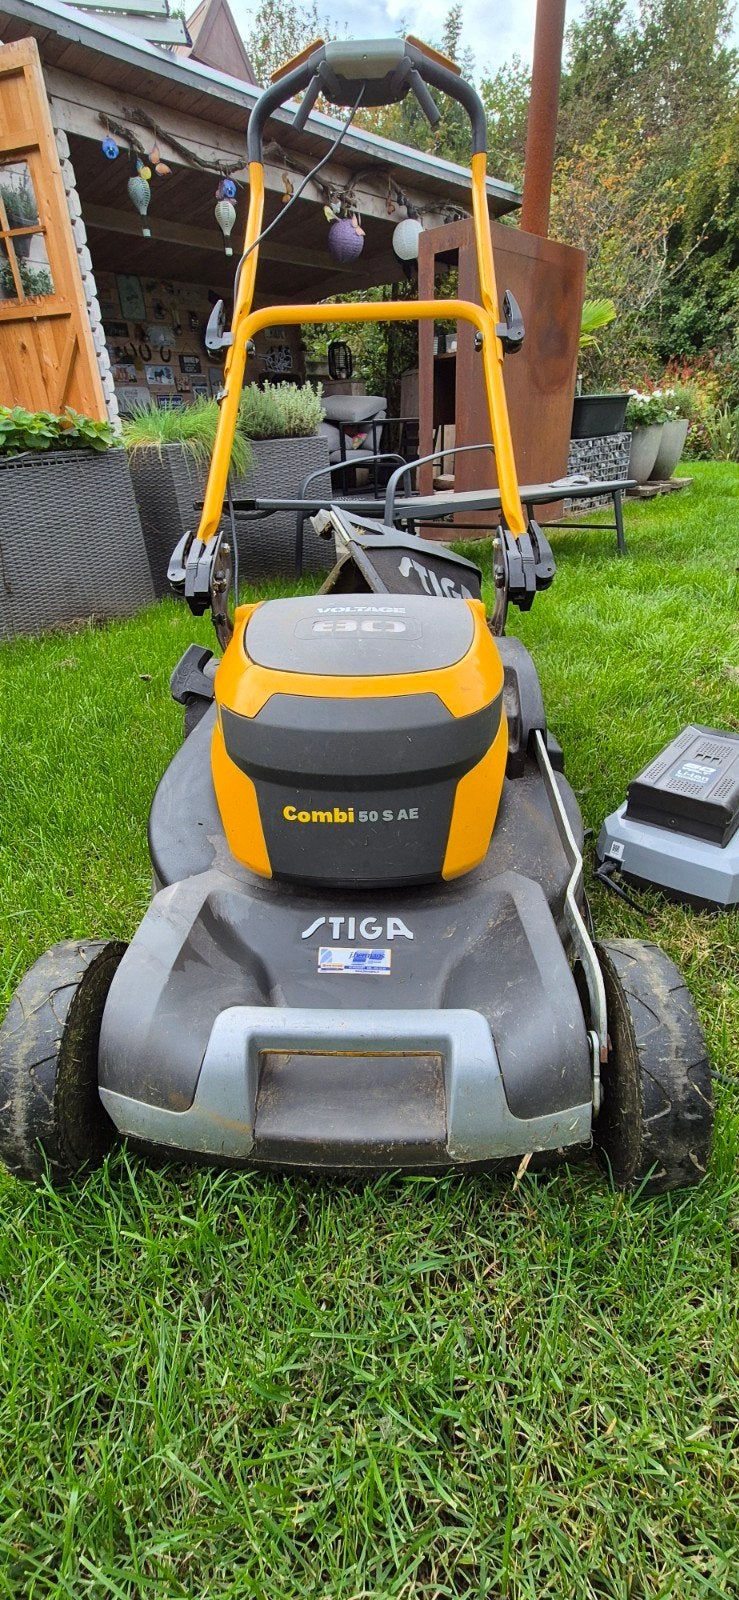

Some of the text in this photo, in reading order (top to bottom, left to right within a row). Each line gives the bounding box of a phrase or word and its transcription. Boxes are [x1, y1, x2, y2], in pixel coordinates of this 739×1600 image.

[312, 620, 406, 633] 80
[282, 805, 419, 823] Combi 50 S AE
[301, 916, 414, 940] STIGA
